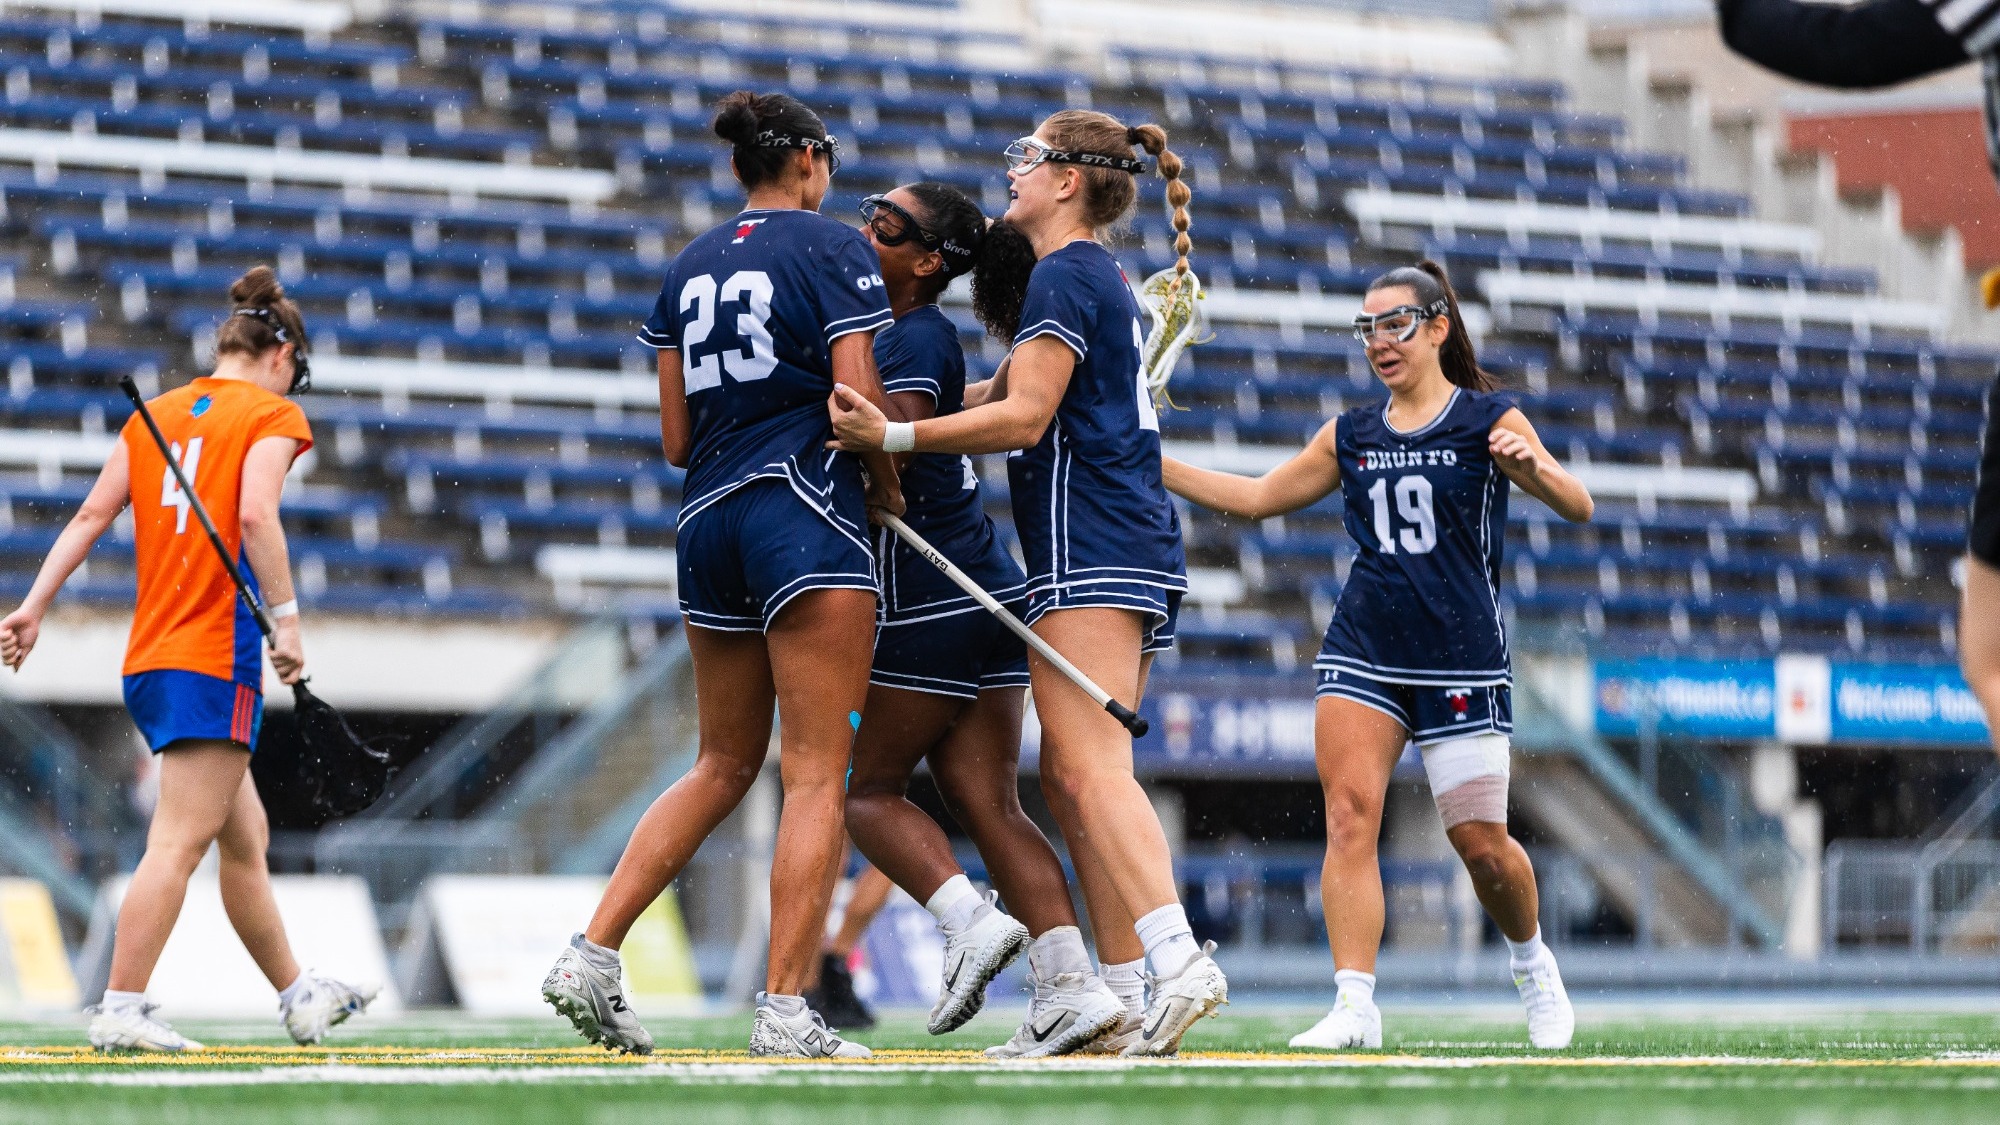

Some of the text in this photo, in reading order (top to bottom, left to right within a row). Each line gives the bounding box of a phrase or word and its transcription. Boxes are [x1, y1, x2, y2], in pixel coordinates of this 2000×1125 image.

[800, 137, 824, 149] STX
[1080, 153, 1112, 166] STX
[943, 240, 971, 256] brine
[680, 270, 779, 397] 23
[160, 436, 203, 534] 4
[1368, 474, 1438, 555] 19
[922, 548, 949, 572] GAIT
